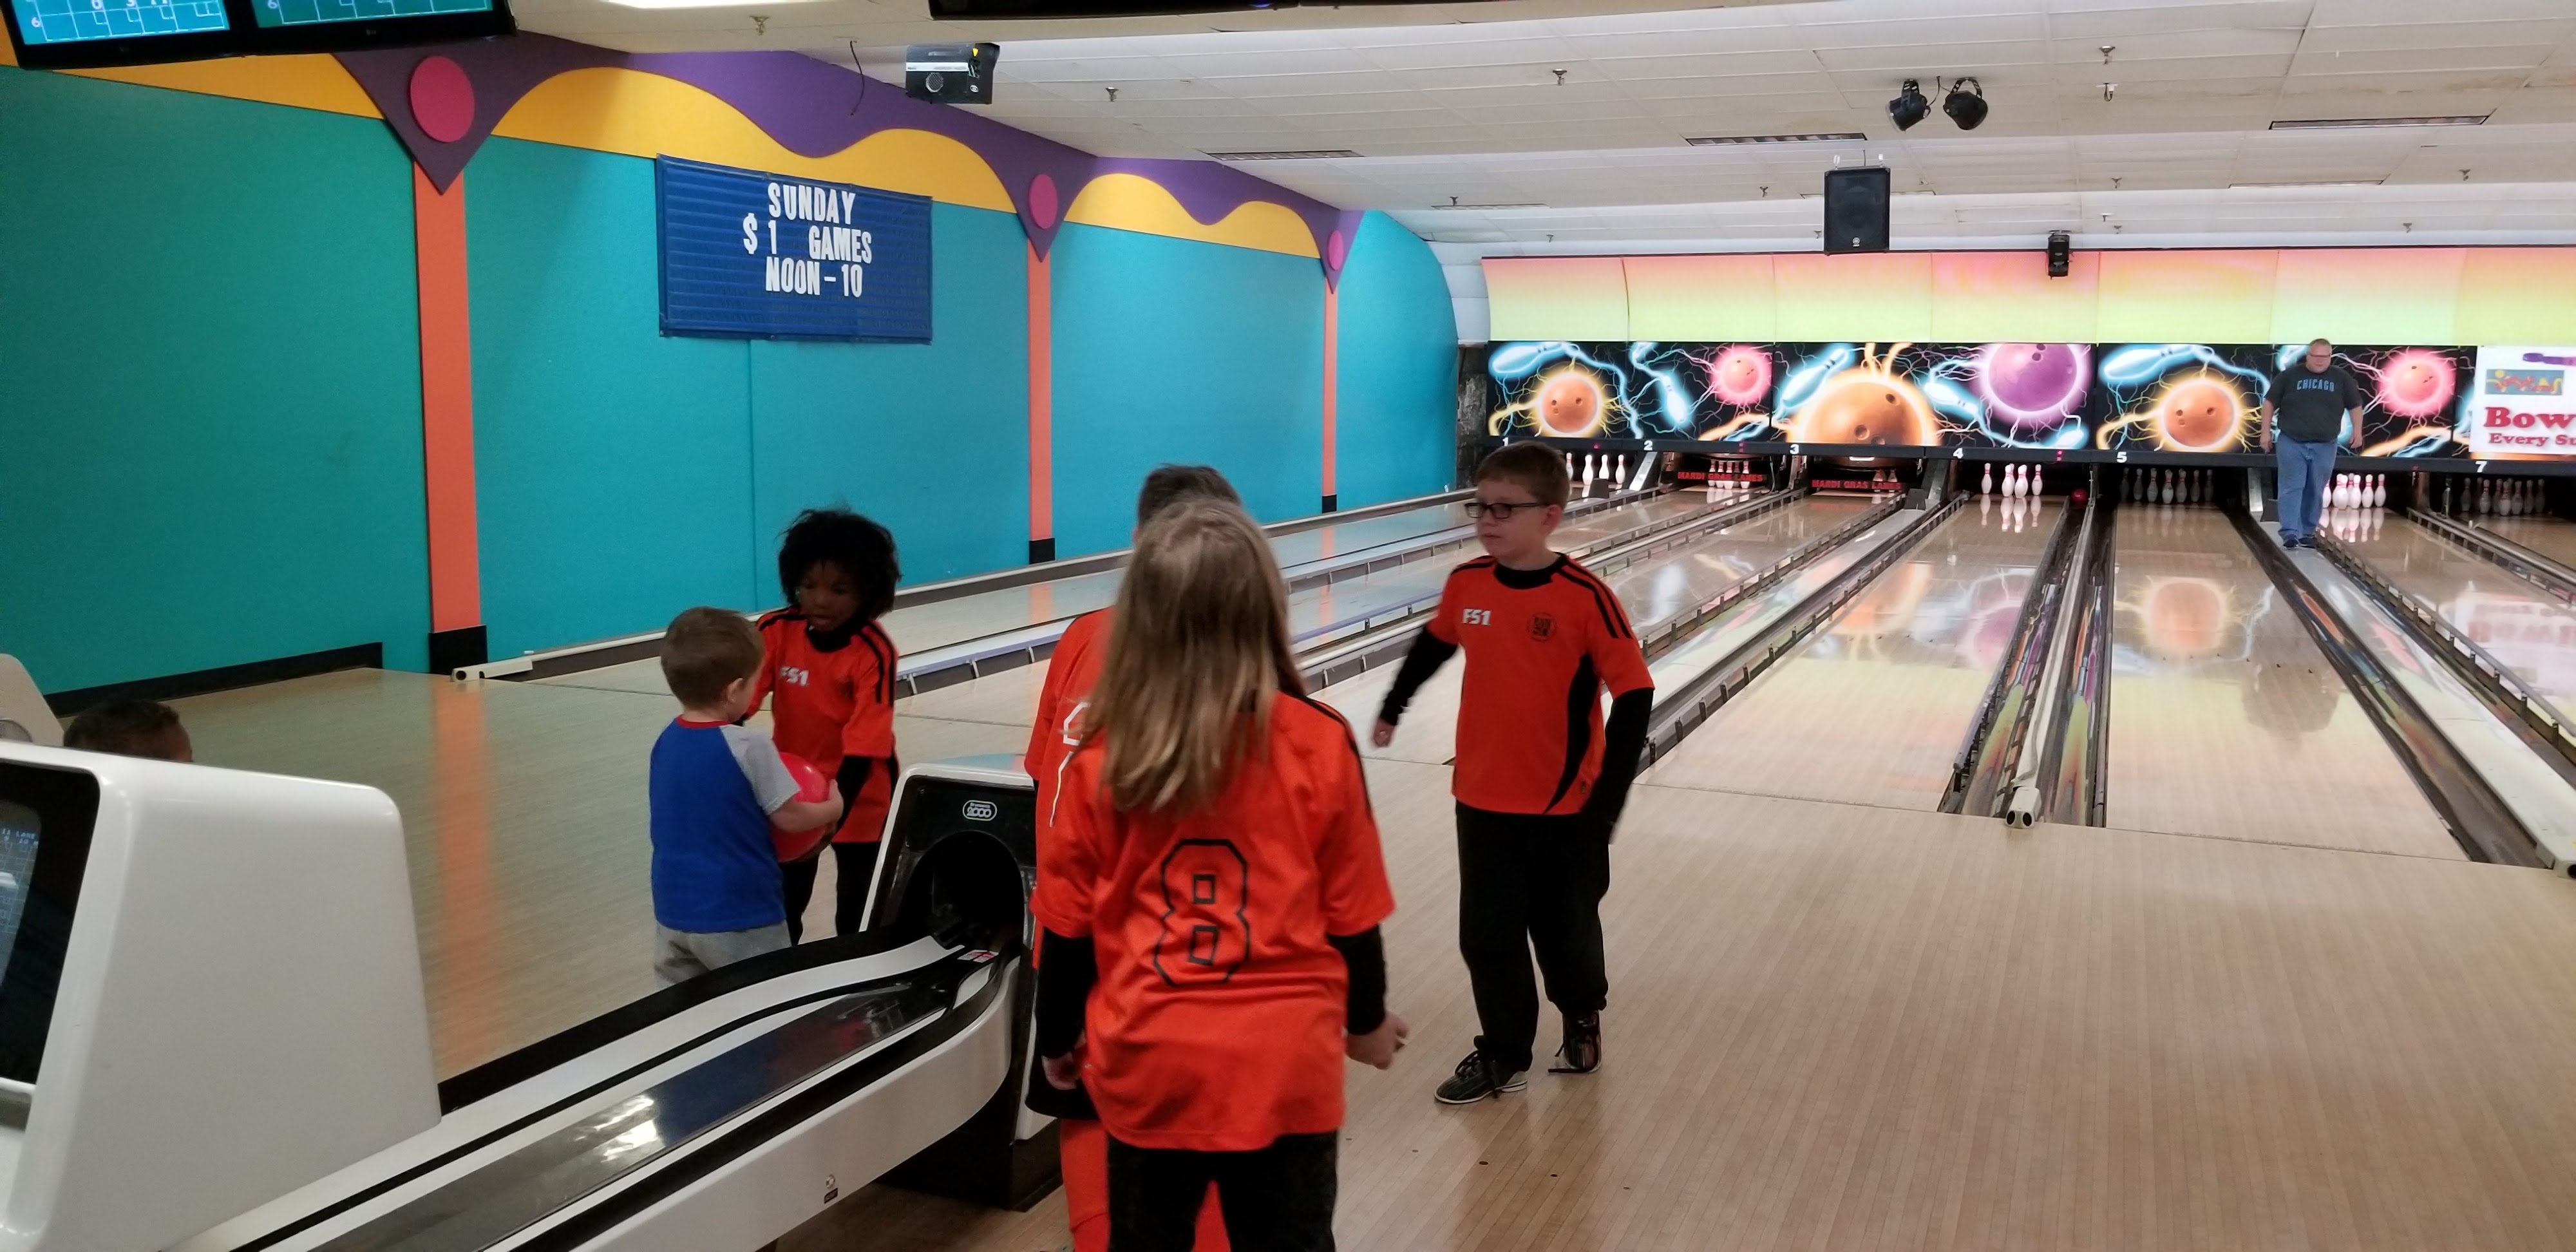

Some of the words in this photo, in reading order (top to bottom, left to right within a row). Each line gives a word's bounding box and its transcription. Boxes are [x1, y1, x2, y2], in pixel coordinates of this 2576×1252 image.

[267, 0, 278, 9] 6
[31, 17, 41, 28] 6
[768, 183, 856, 225] SUNDAY
[809, 225, 873, 265] GAMES
[2297, 378, 2334, 392] CHICAGO
[1502, 437, 1509, 447] 1
[1643, 440, 1653, 451] 2
[2488, 433, 2550, 447] Every
[1790, 444, 1799, 455] 3
[1953, 448, 1964, 459] 4
[2117, 451, 2127, 463] 5
[2475, 460, 2488, 473] 7
[1463, 608, 1492, 626] FS1
[1153, 839, 1251, 988] 8
